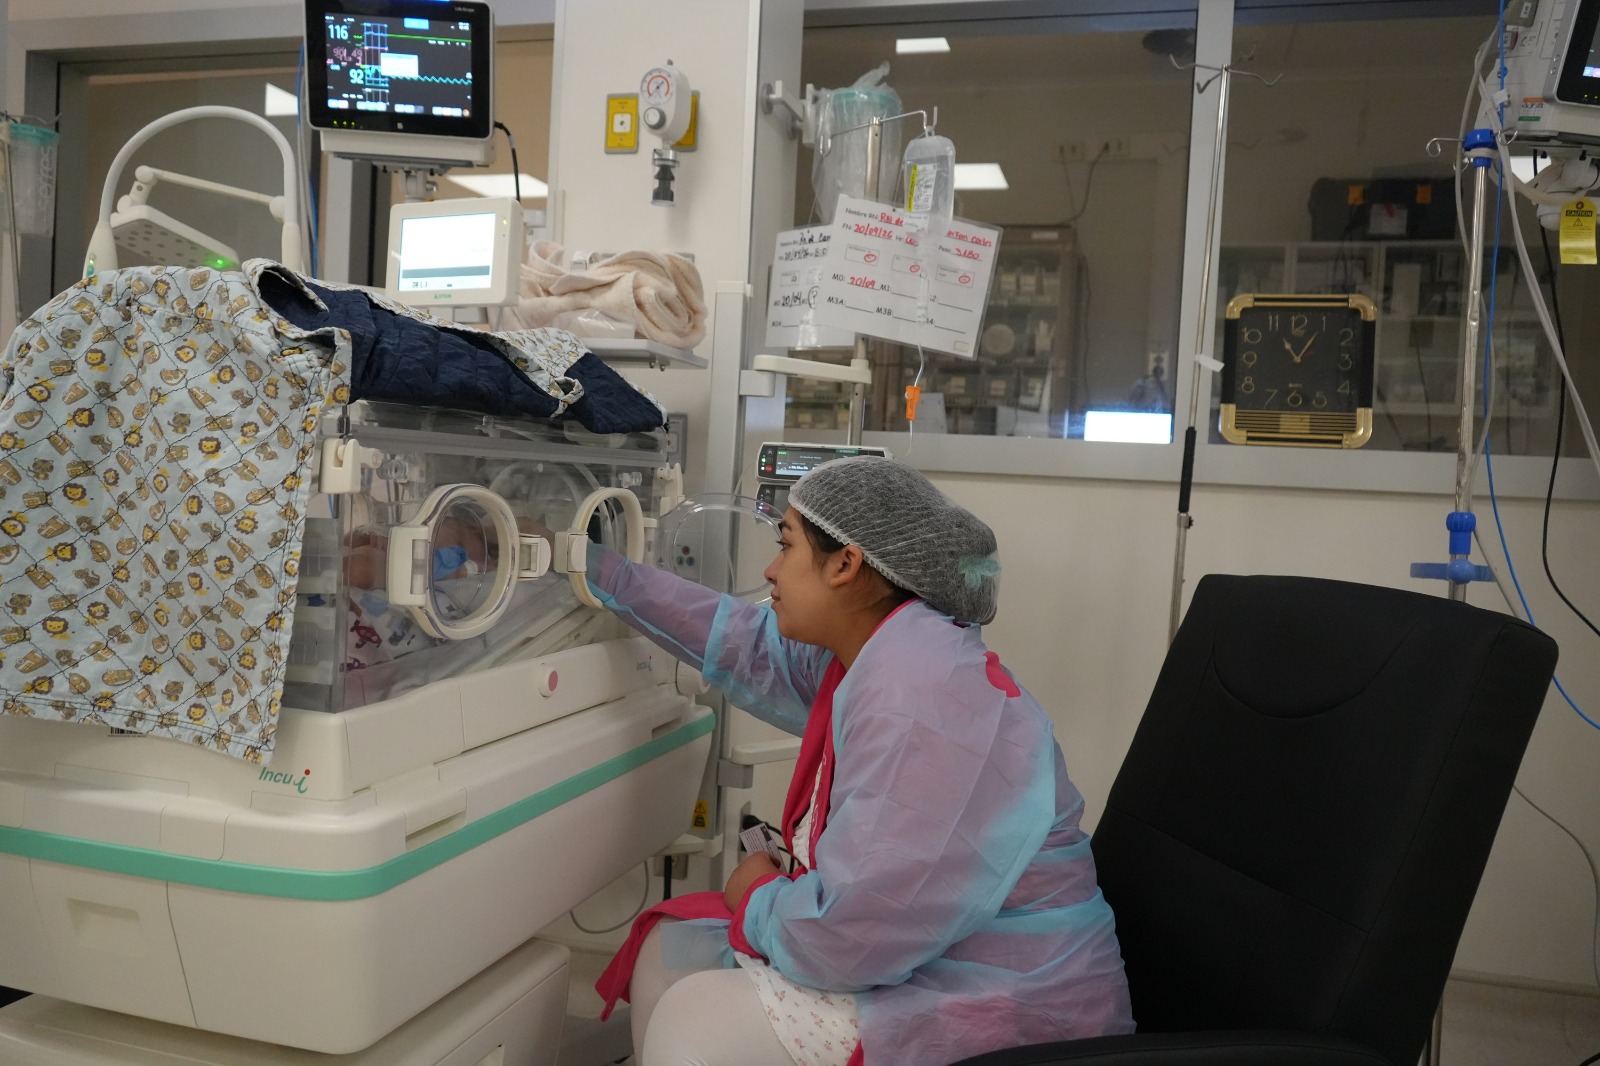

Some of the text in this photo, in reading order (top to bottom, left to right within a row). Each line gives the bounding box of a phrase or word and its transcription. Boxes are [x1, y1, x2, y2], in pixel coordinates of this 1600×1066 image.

[328, 24, 349, 40] 116
[349, 68, 364, 84] 92
[845, 207, 867, 218] Nombre
[827, 296, 846, 305] M3A:
[876, 307, 894, 316] M3B:
[1268, 314, 1279, 331] 11
[1290, 314, 1308, 336] 12
[1241, 327, 1262, 344] 10
[1339, 327, 1354, 346] 2
[1242, 351, 1257, 368] 9
[1338, 353, 1353, 371] 3
[1241, 376, 1255, 393] 8
[1337, 379, 1350, 396] 4
[1265, 388, 1279, 409] 7
[1287, 390, 1303, 408] 6
[1312, 391, 1327, 408] 5
[259, 767, 293, 784] Incu
